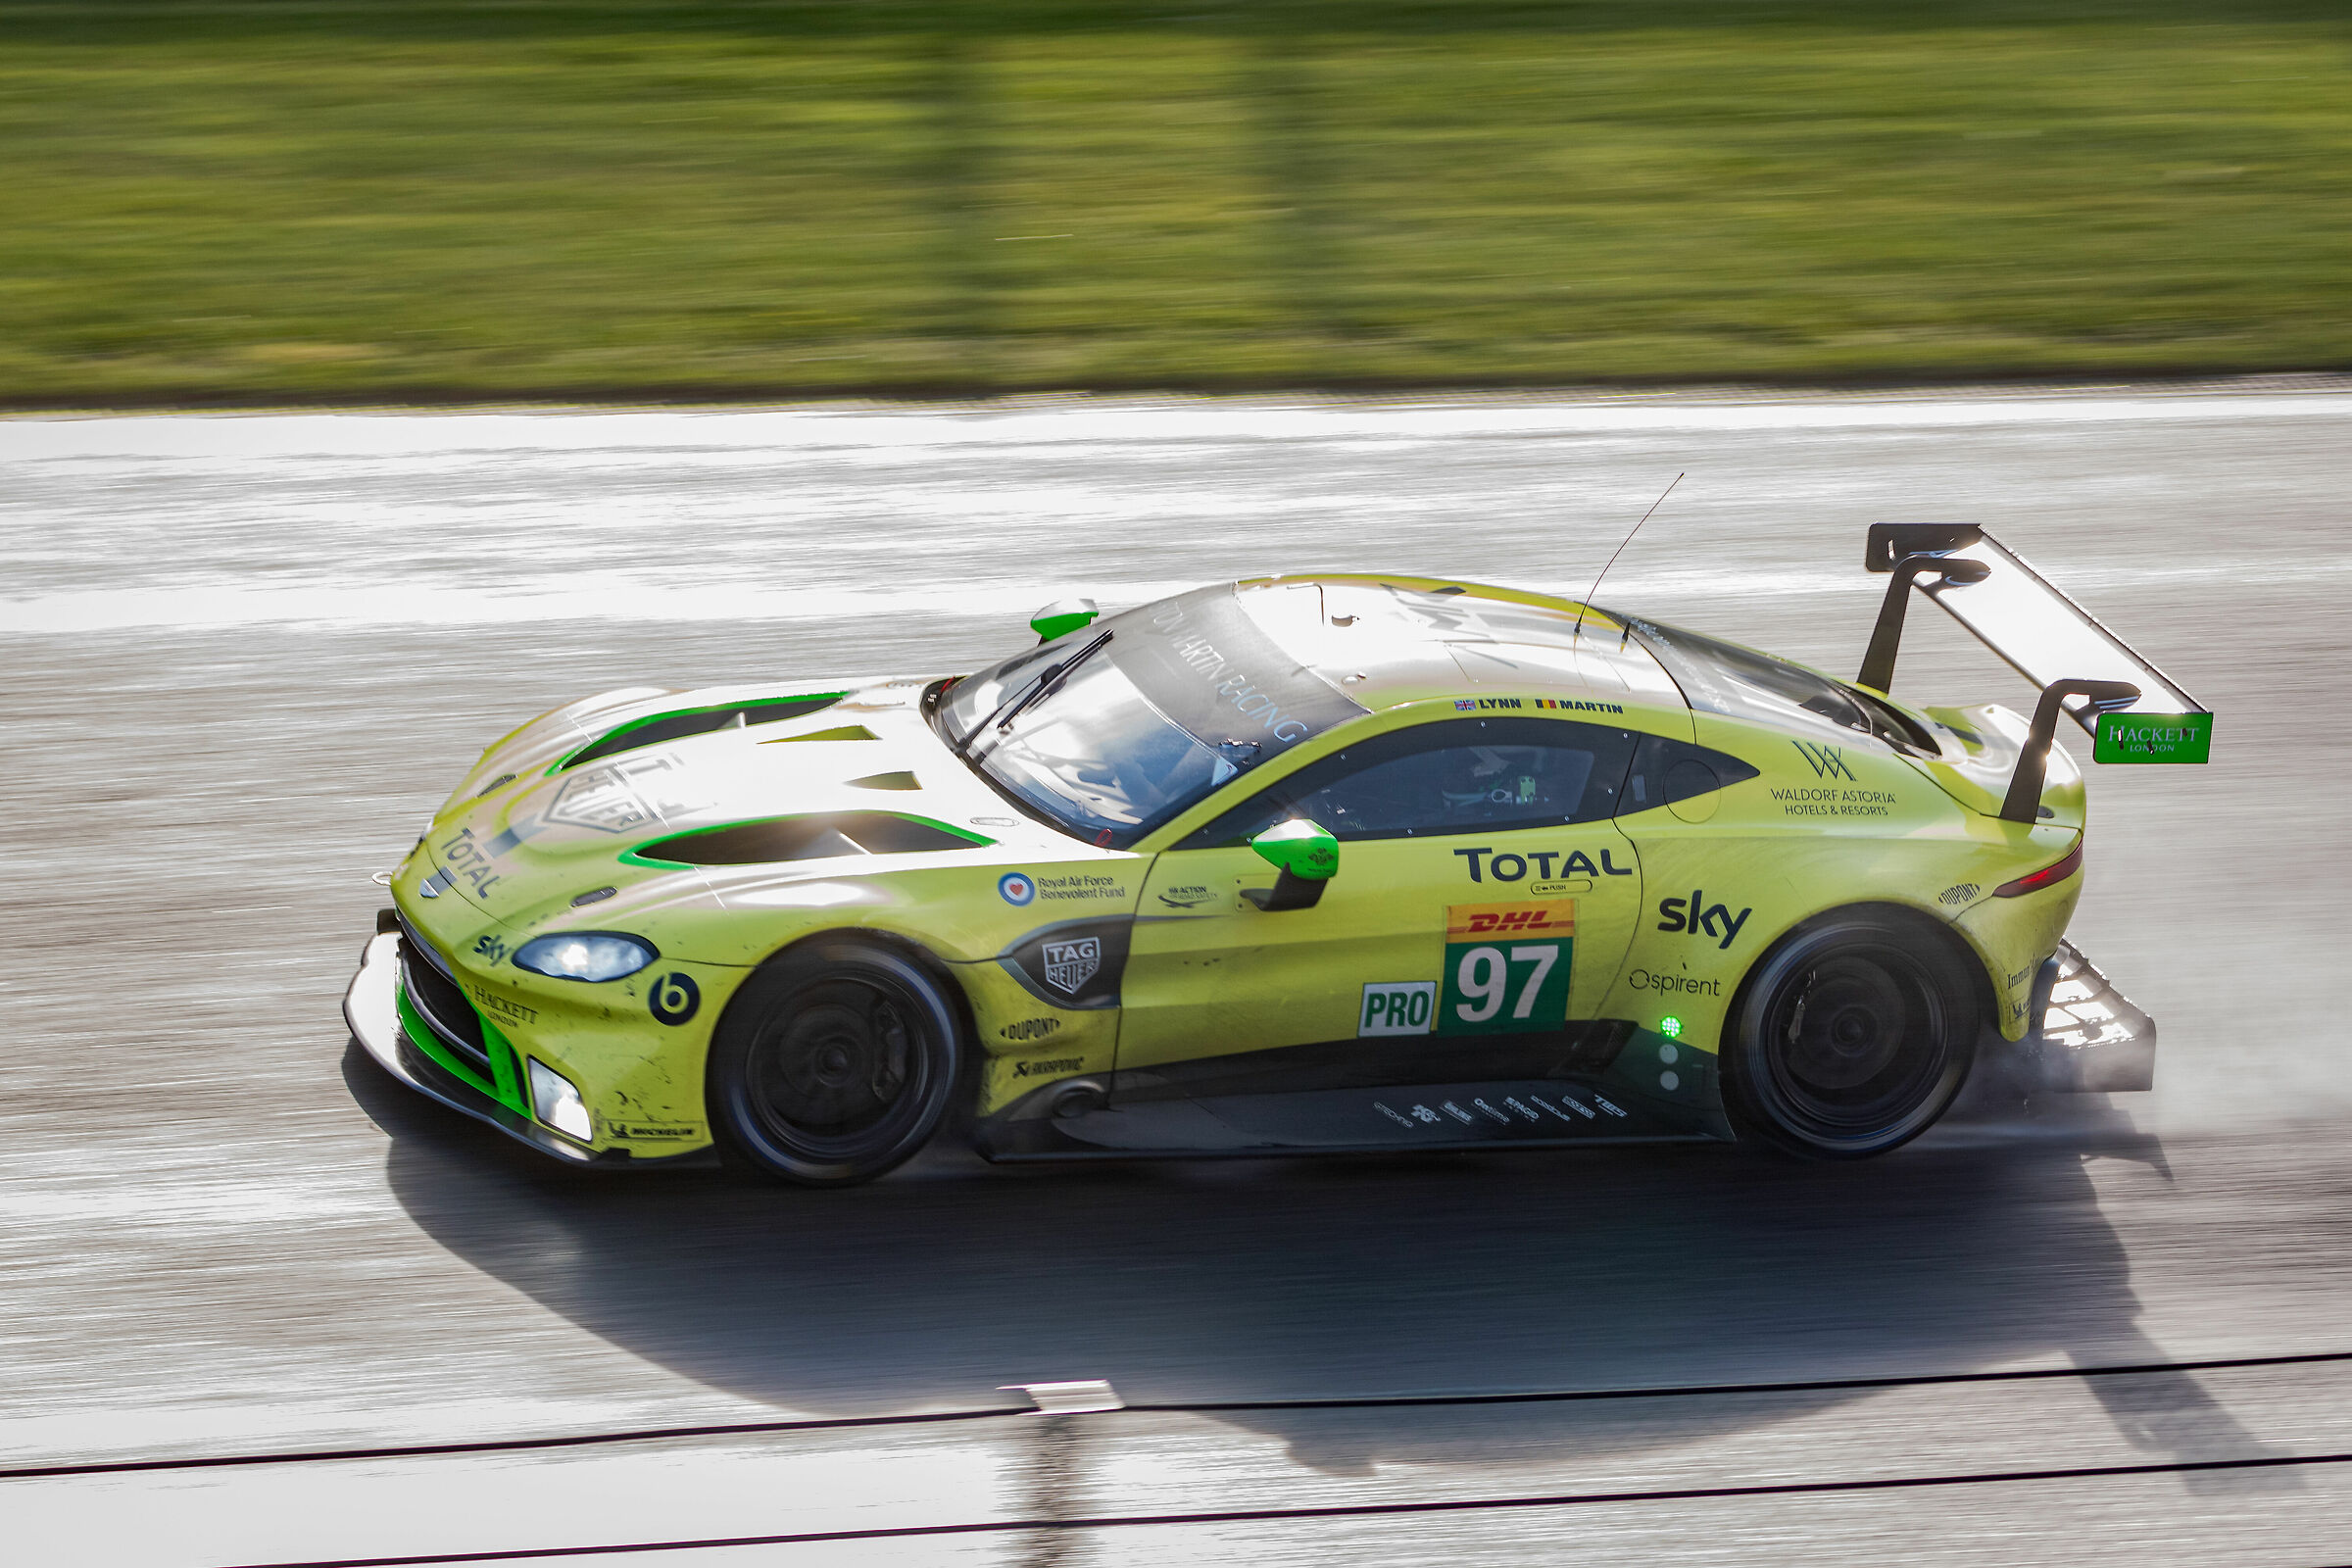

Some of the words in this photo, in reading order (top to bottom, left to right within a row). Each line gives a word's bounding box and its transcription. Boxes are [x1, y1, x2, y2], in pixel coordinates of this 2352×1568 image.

[1479, 698, 1522, 710] LYNN
[1559, 700, 1624, 714] MARTIN
[2108, 725, 2200, 742] HACKETT
[2130, 744, 2175, 753] LONDON
[1771, 788, 1838, 802] WALDORF
[1842, 790, 1896, 804] ASTORIA
[1785, 805, 1828, 815] HOTELS
[1831, 806, 1838, 815] &
[1842, 806, 1888, 816] RESORTS
[441, 827, 500, 900] TOTAL
[1453, 848, 1633, 883] TOTAL
[1038, 876, 1066, 888] Royal
[1068, 875, 1082, 887] Air
[1084, 874, 1114, 886] Force
[1041, 887, 1098, 900] Benevolent
[1100, 886, 1125, 898] Fund
[1940, 883, 1977, 905] DUPONT
[1468, 910, 1553, 933] DHL
[1657, 890, 1752, 950] sky
[1049, 942, 1095, 962] TAG
[1049, 960, 1097, 988] HEUER
[1456, 945, 1559, 1022] 97
[473, 984, 539, 1024] HACKETT
[1365, 991, 1430, 1027] PRO
[1008, 1018, 1054, 1040] DUPONT
